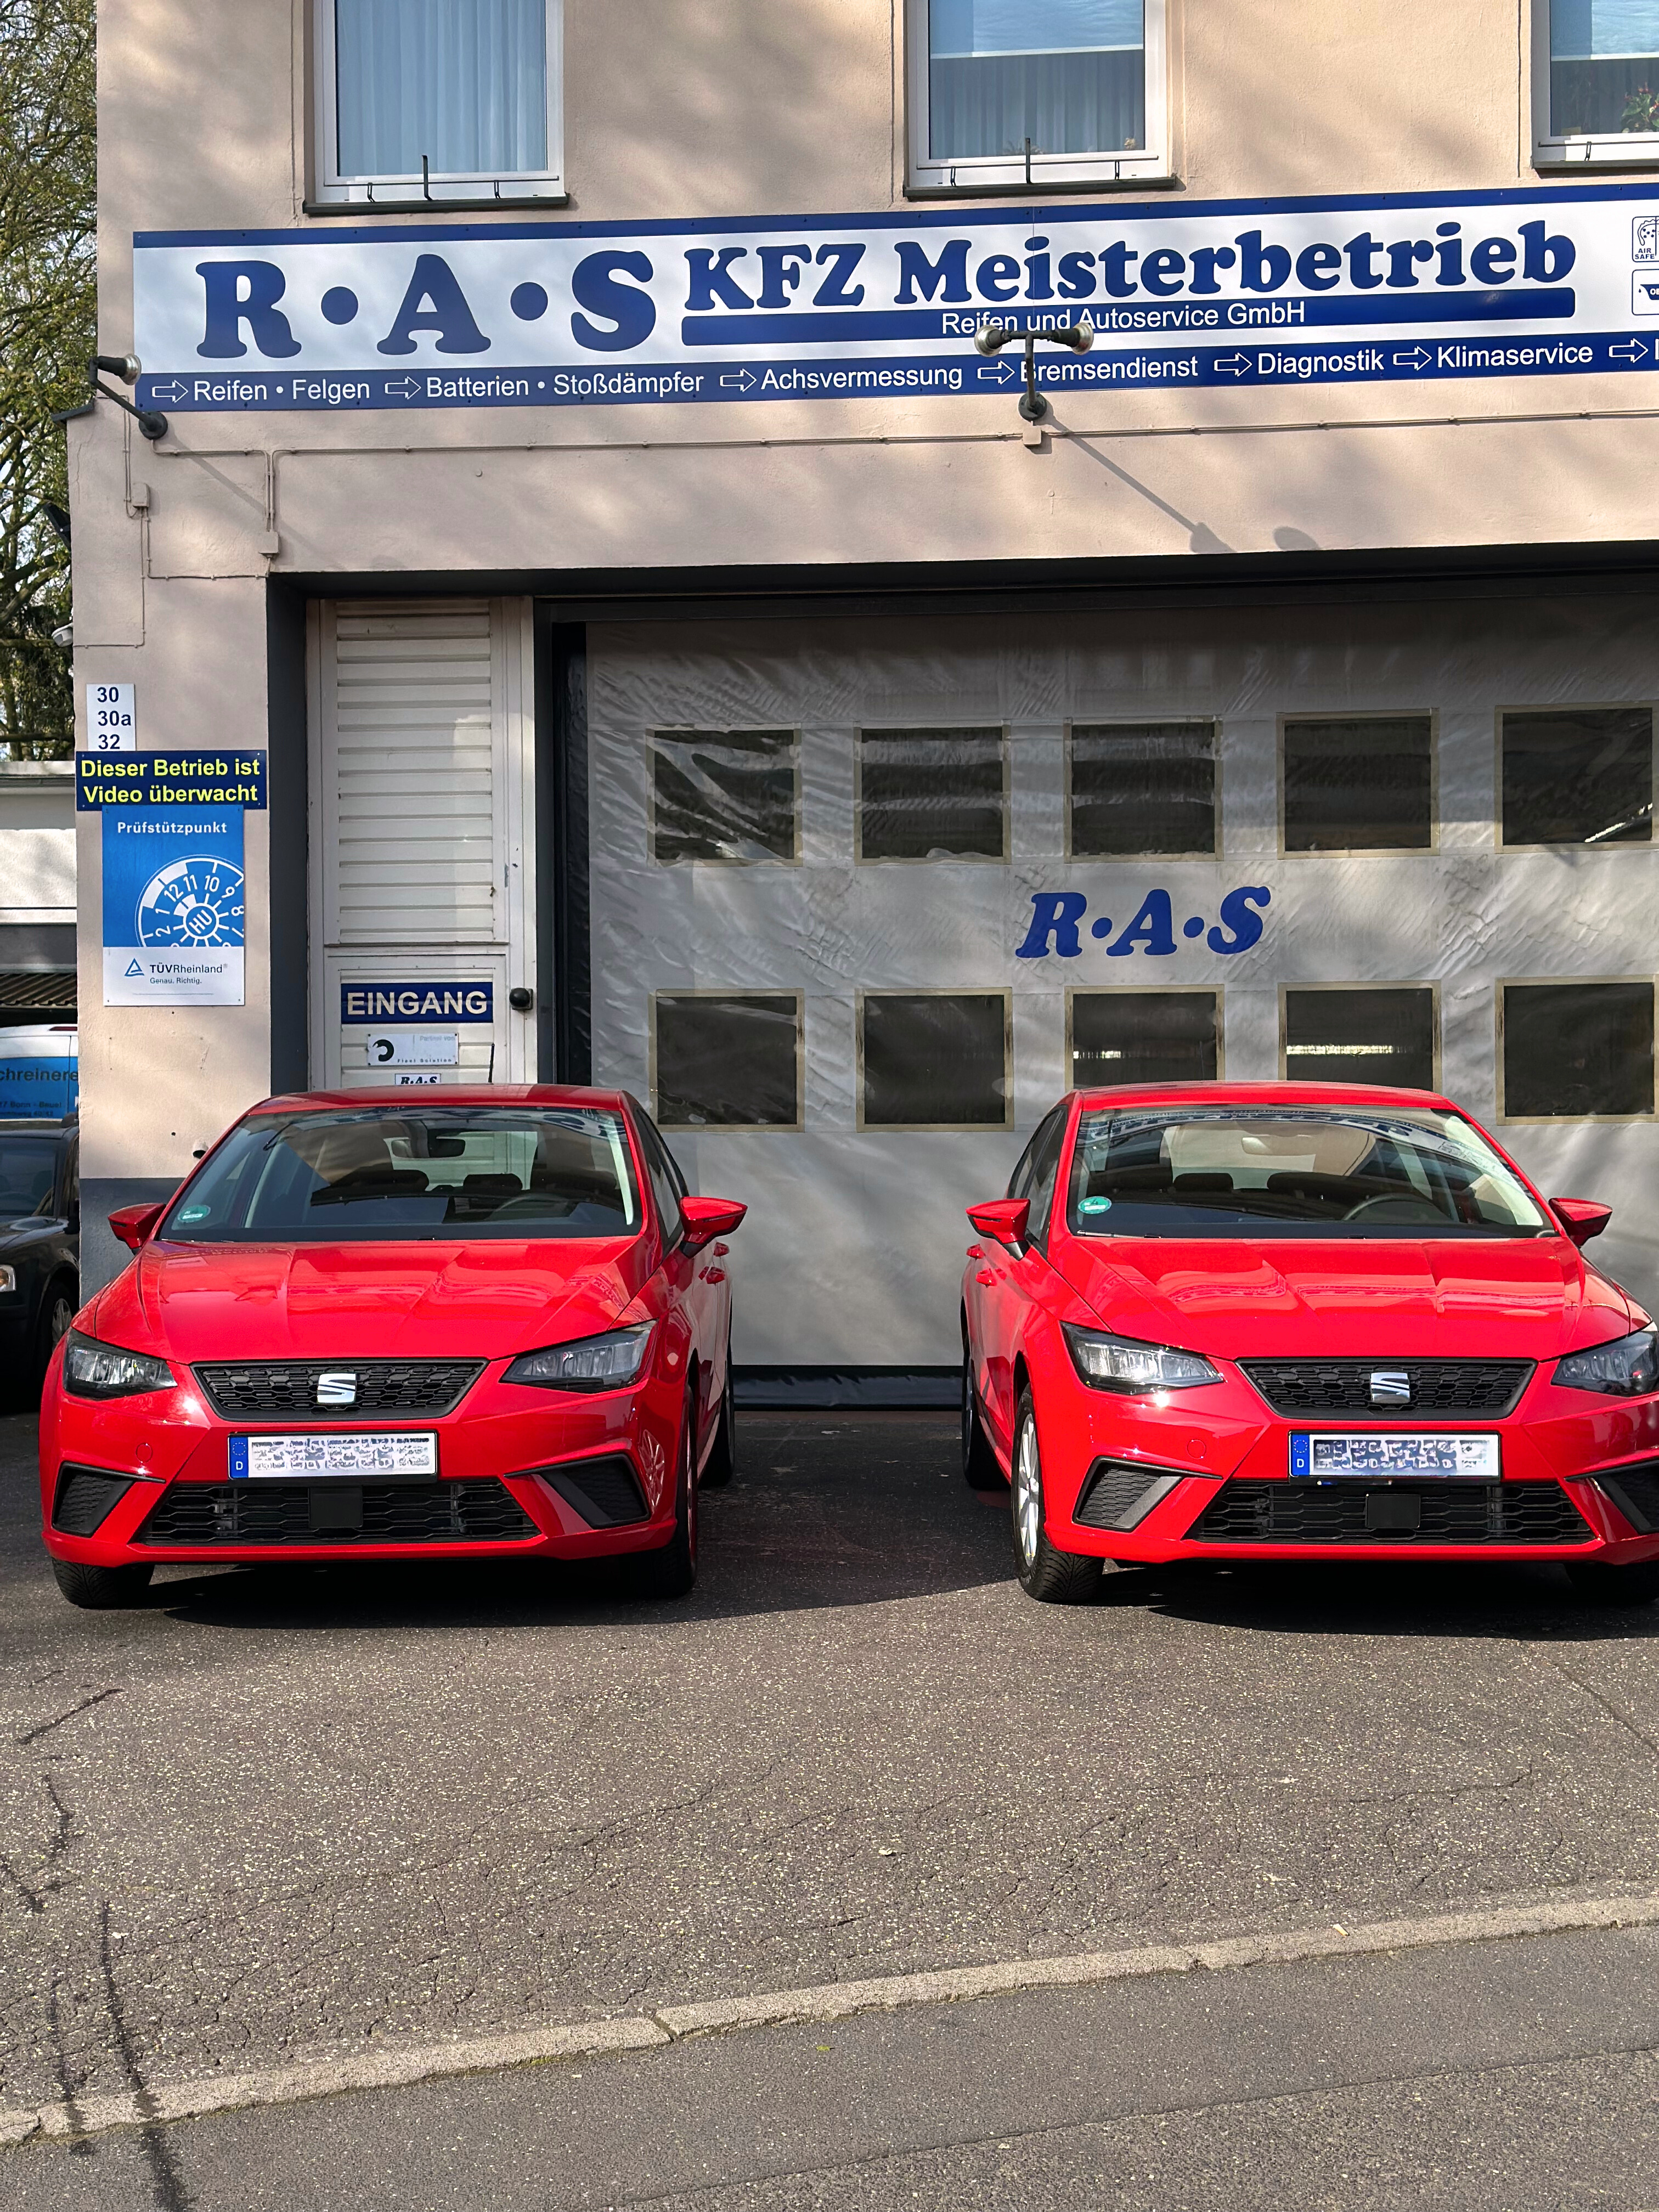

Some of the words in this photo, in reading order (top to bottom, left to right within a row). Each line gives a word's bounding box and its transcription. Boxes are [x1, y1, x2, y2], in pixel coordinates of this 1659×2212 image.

[684, 244, 866, 311] KFZ
[894, 221, 1576, 304] Meisterbetrieb
[943, 312, 1017, 333] Reifen
[1027, 309, 1070, 330] und
[1079, 307, 1218, 329] Autoservice
[1228, 301, 1304, 324] GmbH
[195, 380, 267, 400] Reifen
[293, 379, 369, 404] Felgen
[427, 376, 528, 397] Batterien
[554, 371, 704, 397] Stoßdämpfer
[761, 369, 962, 390] Achsvermessung
[1259, 349, 1384, 378] Diagnostik
[1438, 342, 1593, 368] Klimaservice
[98, 687, 119, 702] 30
[98, 710, 131, 726] 30a
[99, 734, 120, 749] 32
[82, 760, 148, 776] Dieser
[155, 759, 228, 776] Betrieb
[235, 759, 259, 775] ist
[84, 786, 142, 802] Video
[150, 785, 257, 802] überwacht
[117, 822, 227, 835] Prüfstützpunkt
[205, 875, 220, 892] 10
[189, 910, 212, 934] HU
[150, 977, 174, 985] Genau.
[176, 976, 202, 985] Richtig.
[348, 991, 487, 1014] EINGANG
[235, 1461, 244, 1471] D
[1296, 1458, 1305, 1468] D
